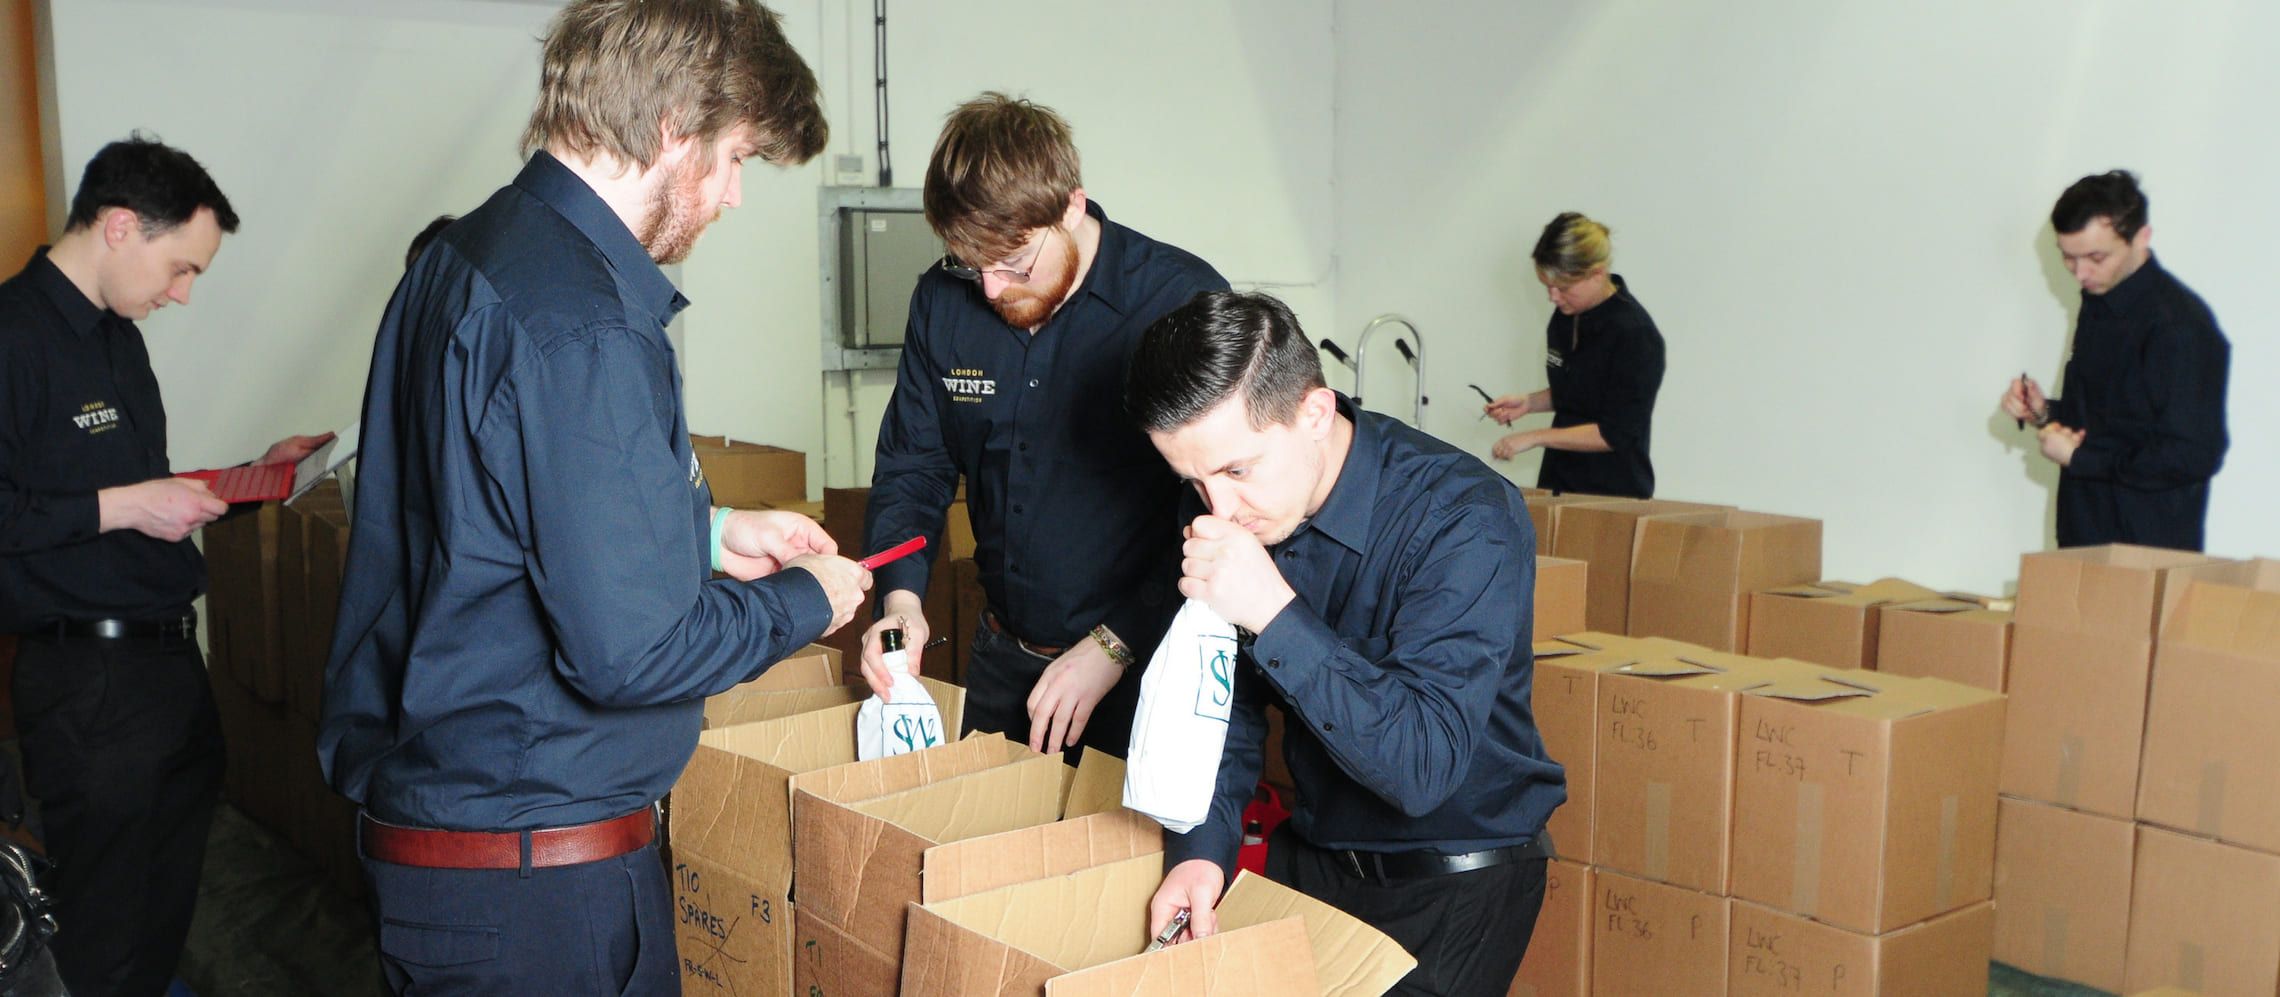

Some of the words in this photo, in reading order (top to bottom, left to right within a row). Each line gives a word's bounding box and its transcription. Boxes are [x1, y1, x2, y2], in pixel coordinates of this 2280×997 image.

[951, 368, 983, 376] LONDON
[942, 377, 996, 395] WINE
[72, 408, 119, 429] WINE
[1563, 675, 1583, 695] T
[1686, 717, 1706, 743] T
[1840, 749, 1864, 776] T
[679, 896, 726, 940] SPARES
[751, 894, 771, 924] F3
[1833, 963, 1846, 992] P
